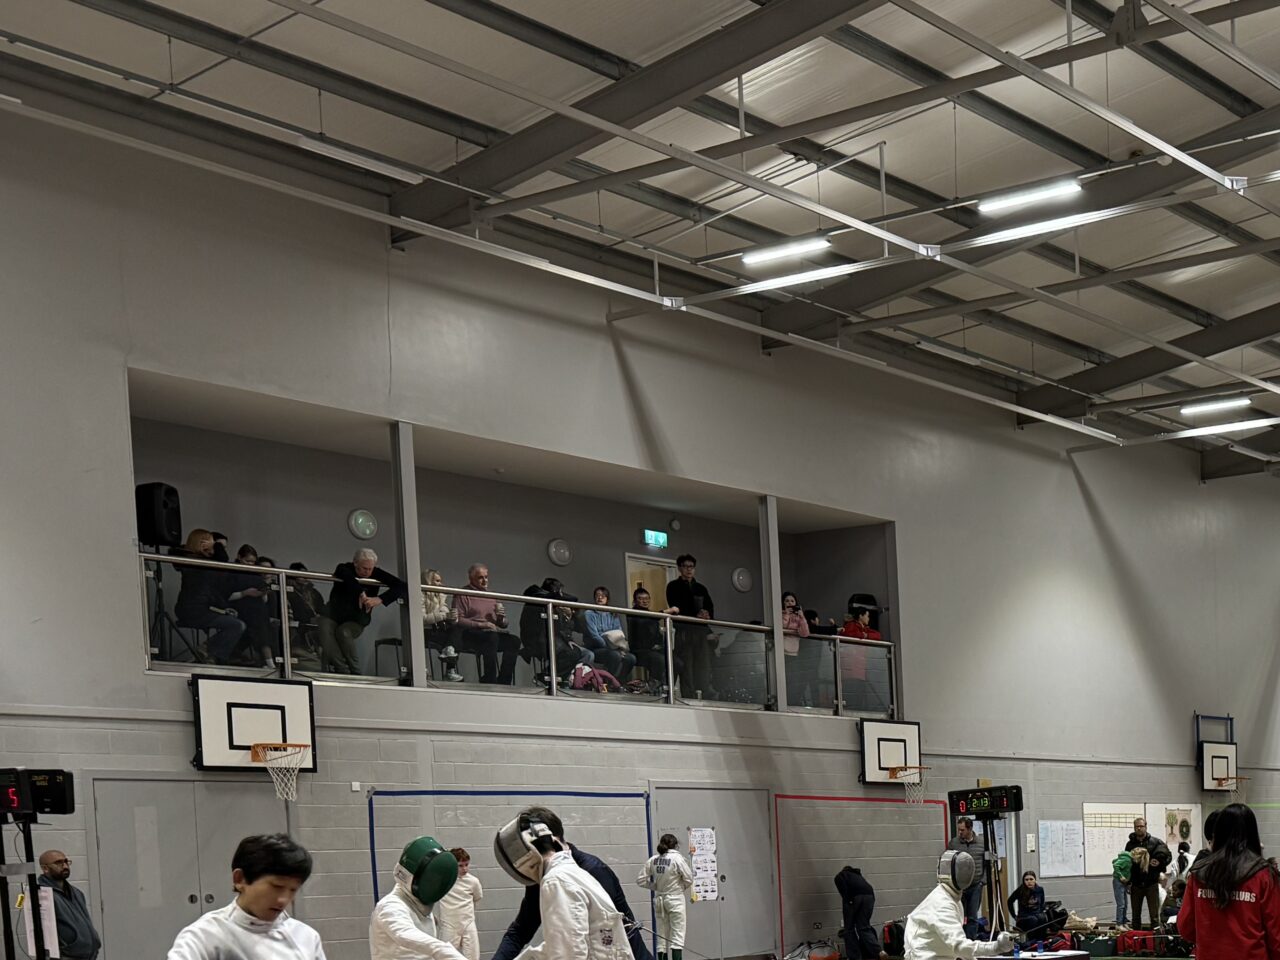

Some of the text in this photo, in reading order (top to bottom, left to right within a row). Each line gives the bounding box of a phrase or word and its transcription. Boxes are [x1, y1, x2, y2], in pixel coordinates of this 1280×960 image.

[8, 788, 18, 807] 5
[960, 800, 966, 813] 0
[972, 797, 989, 808] 2:13
